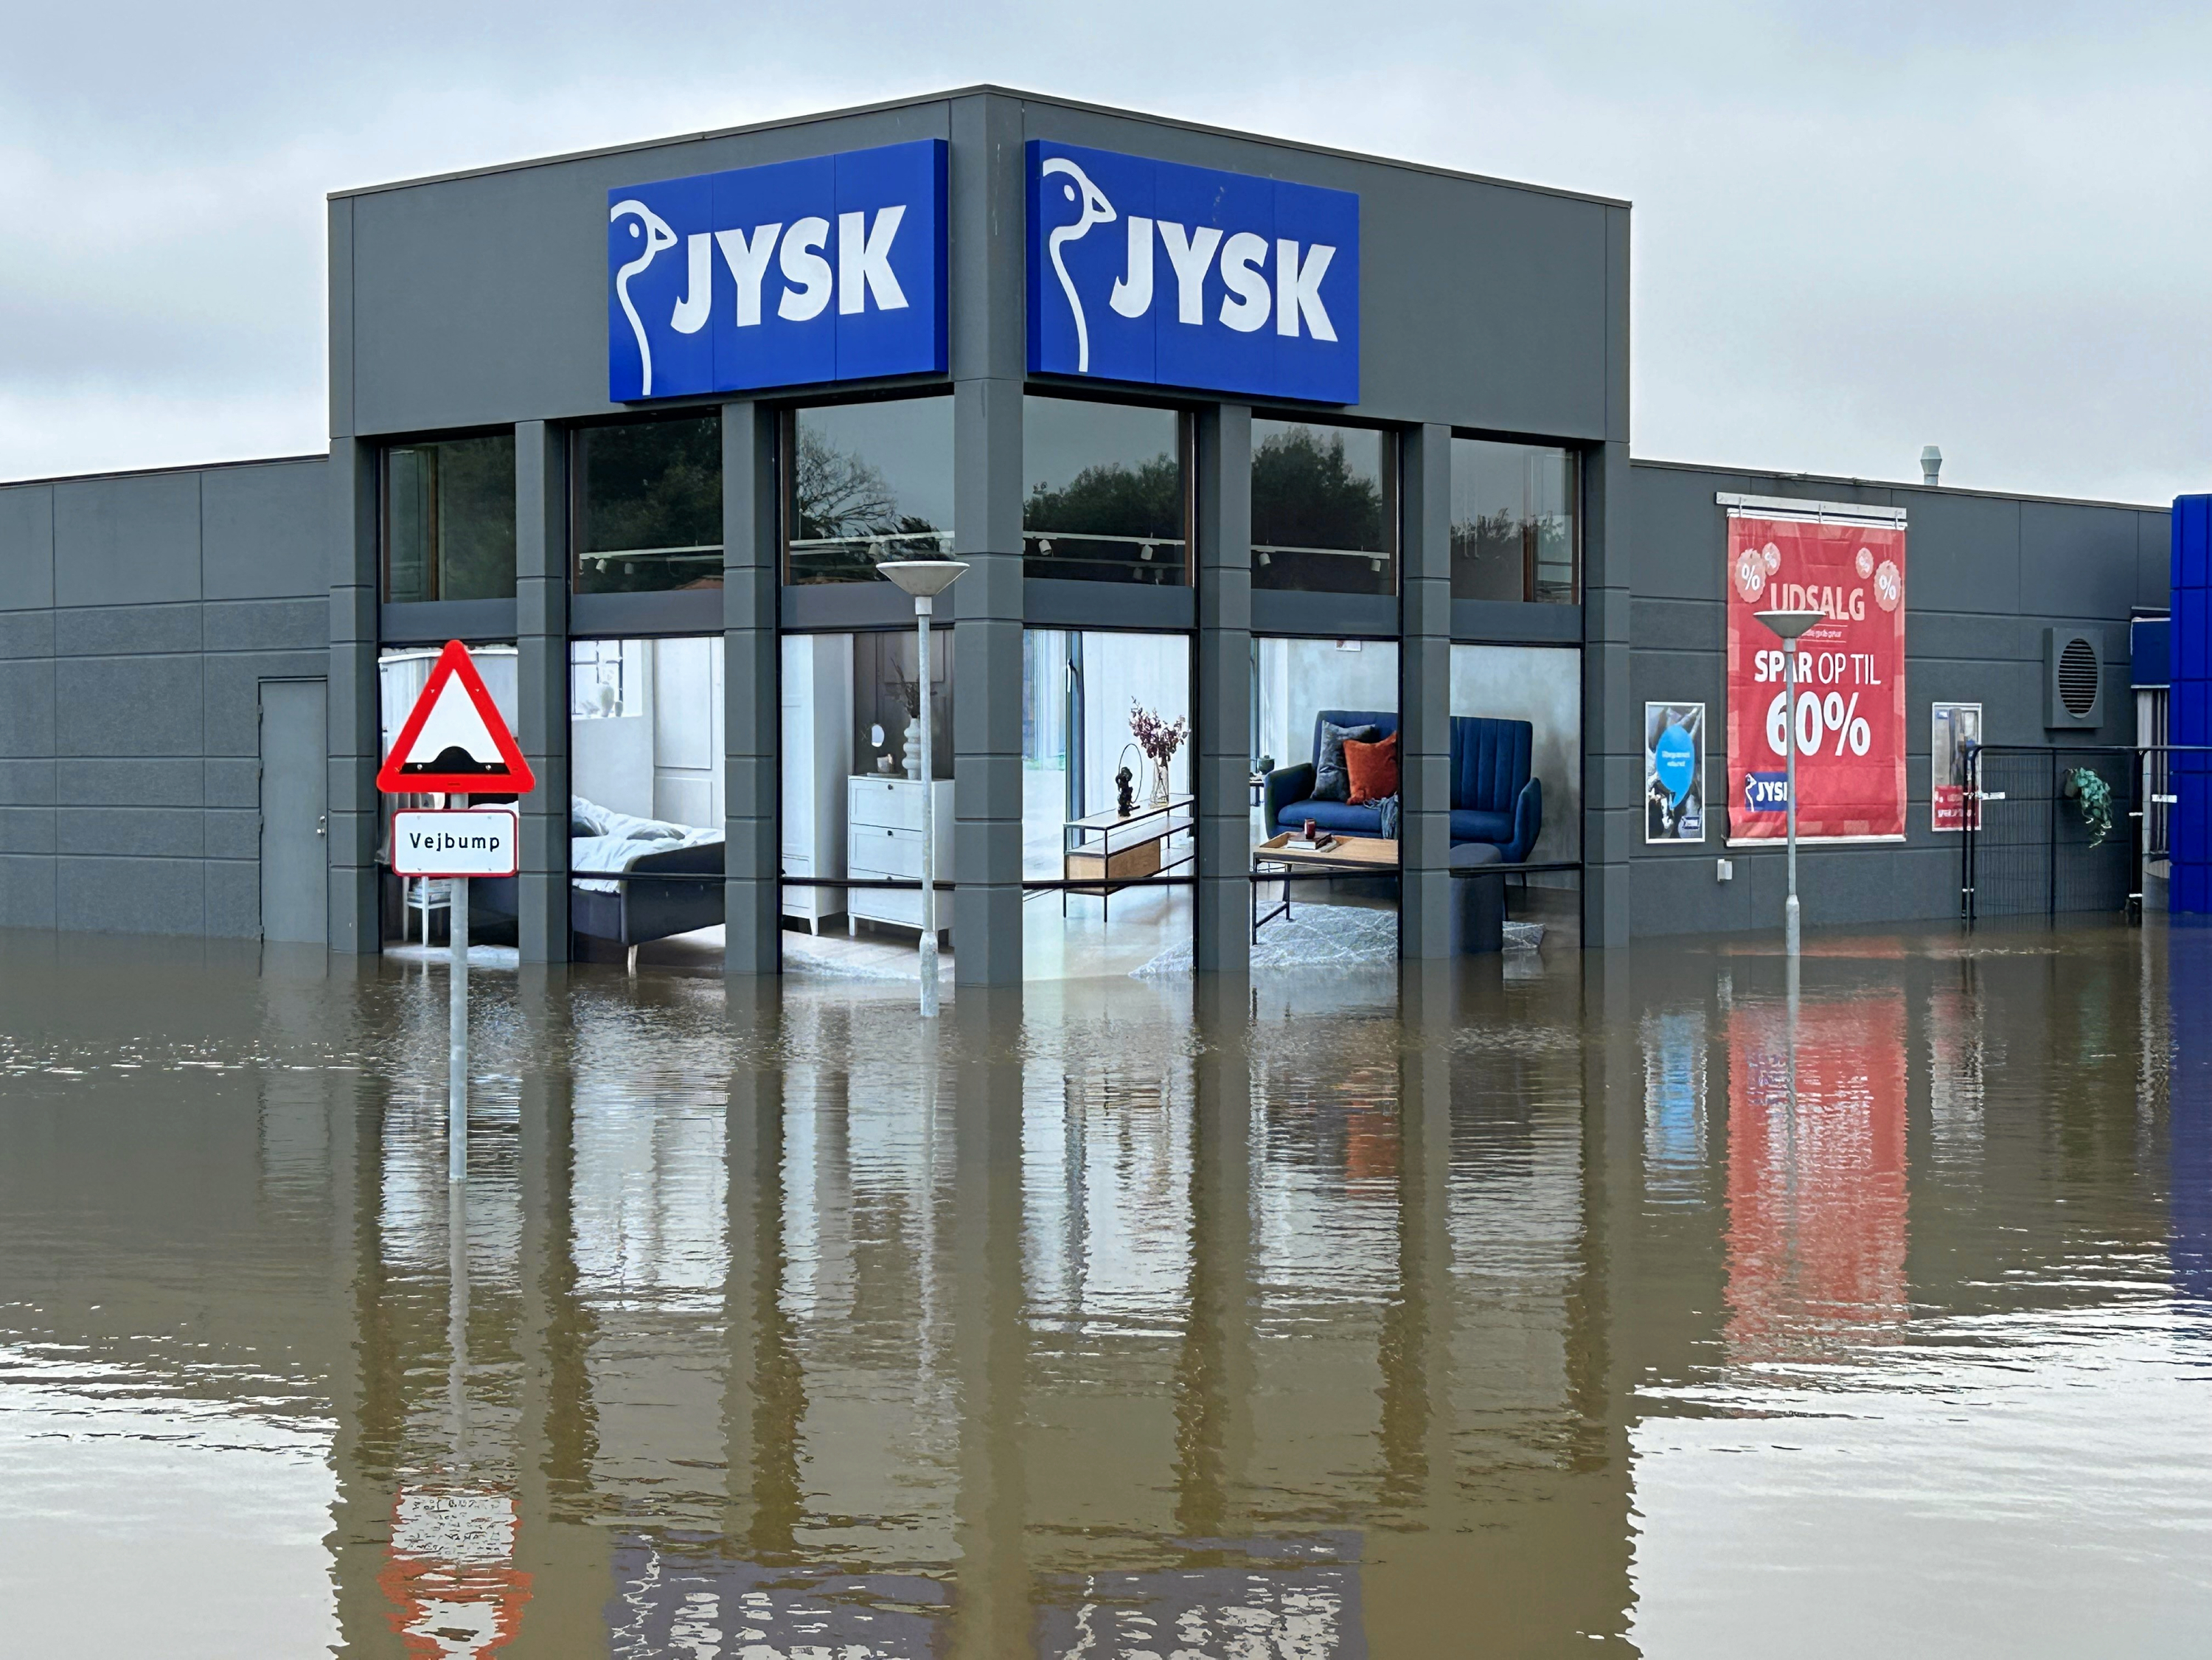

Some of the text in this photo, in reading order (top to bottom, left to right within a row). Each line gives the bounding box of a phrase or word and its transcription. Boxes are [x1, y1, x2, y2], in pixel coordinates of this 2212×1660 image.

[670, 204, 909, 334] JYSK
[1109, 215, 1338, 342] JYSK
[1770, 583, 1865, 621] UDSALG
[1818, 652, 1846, 684] OP
[1850, 653, 1882, 685] TIL
[1766, 690, 1871, 757] 60%
[409, 833, 500, 852] Vejbump
